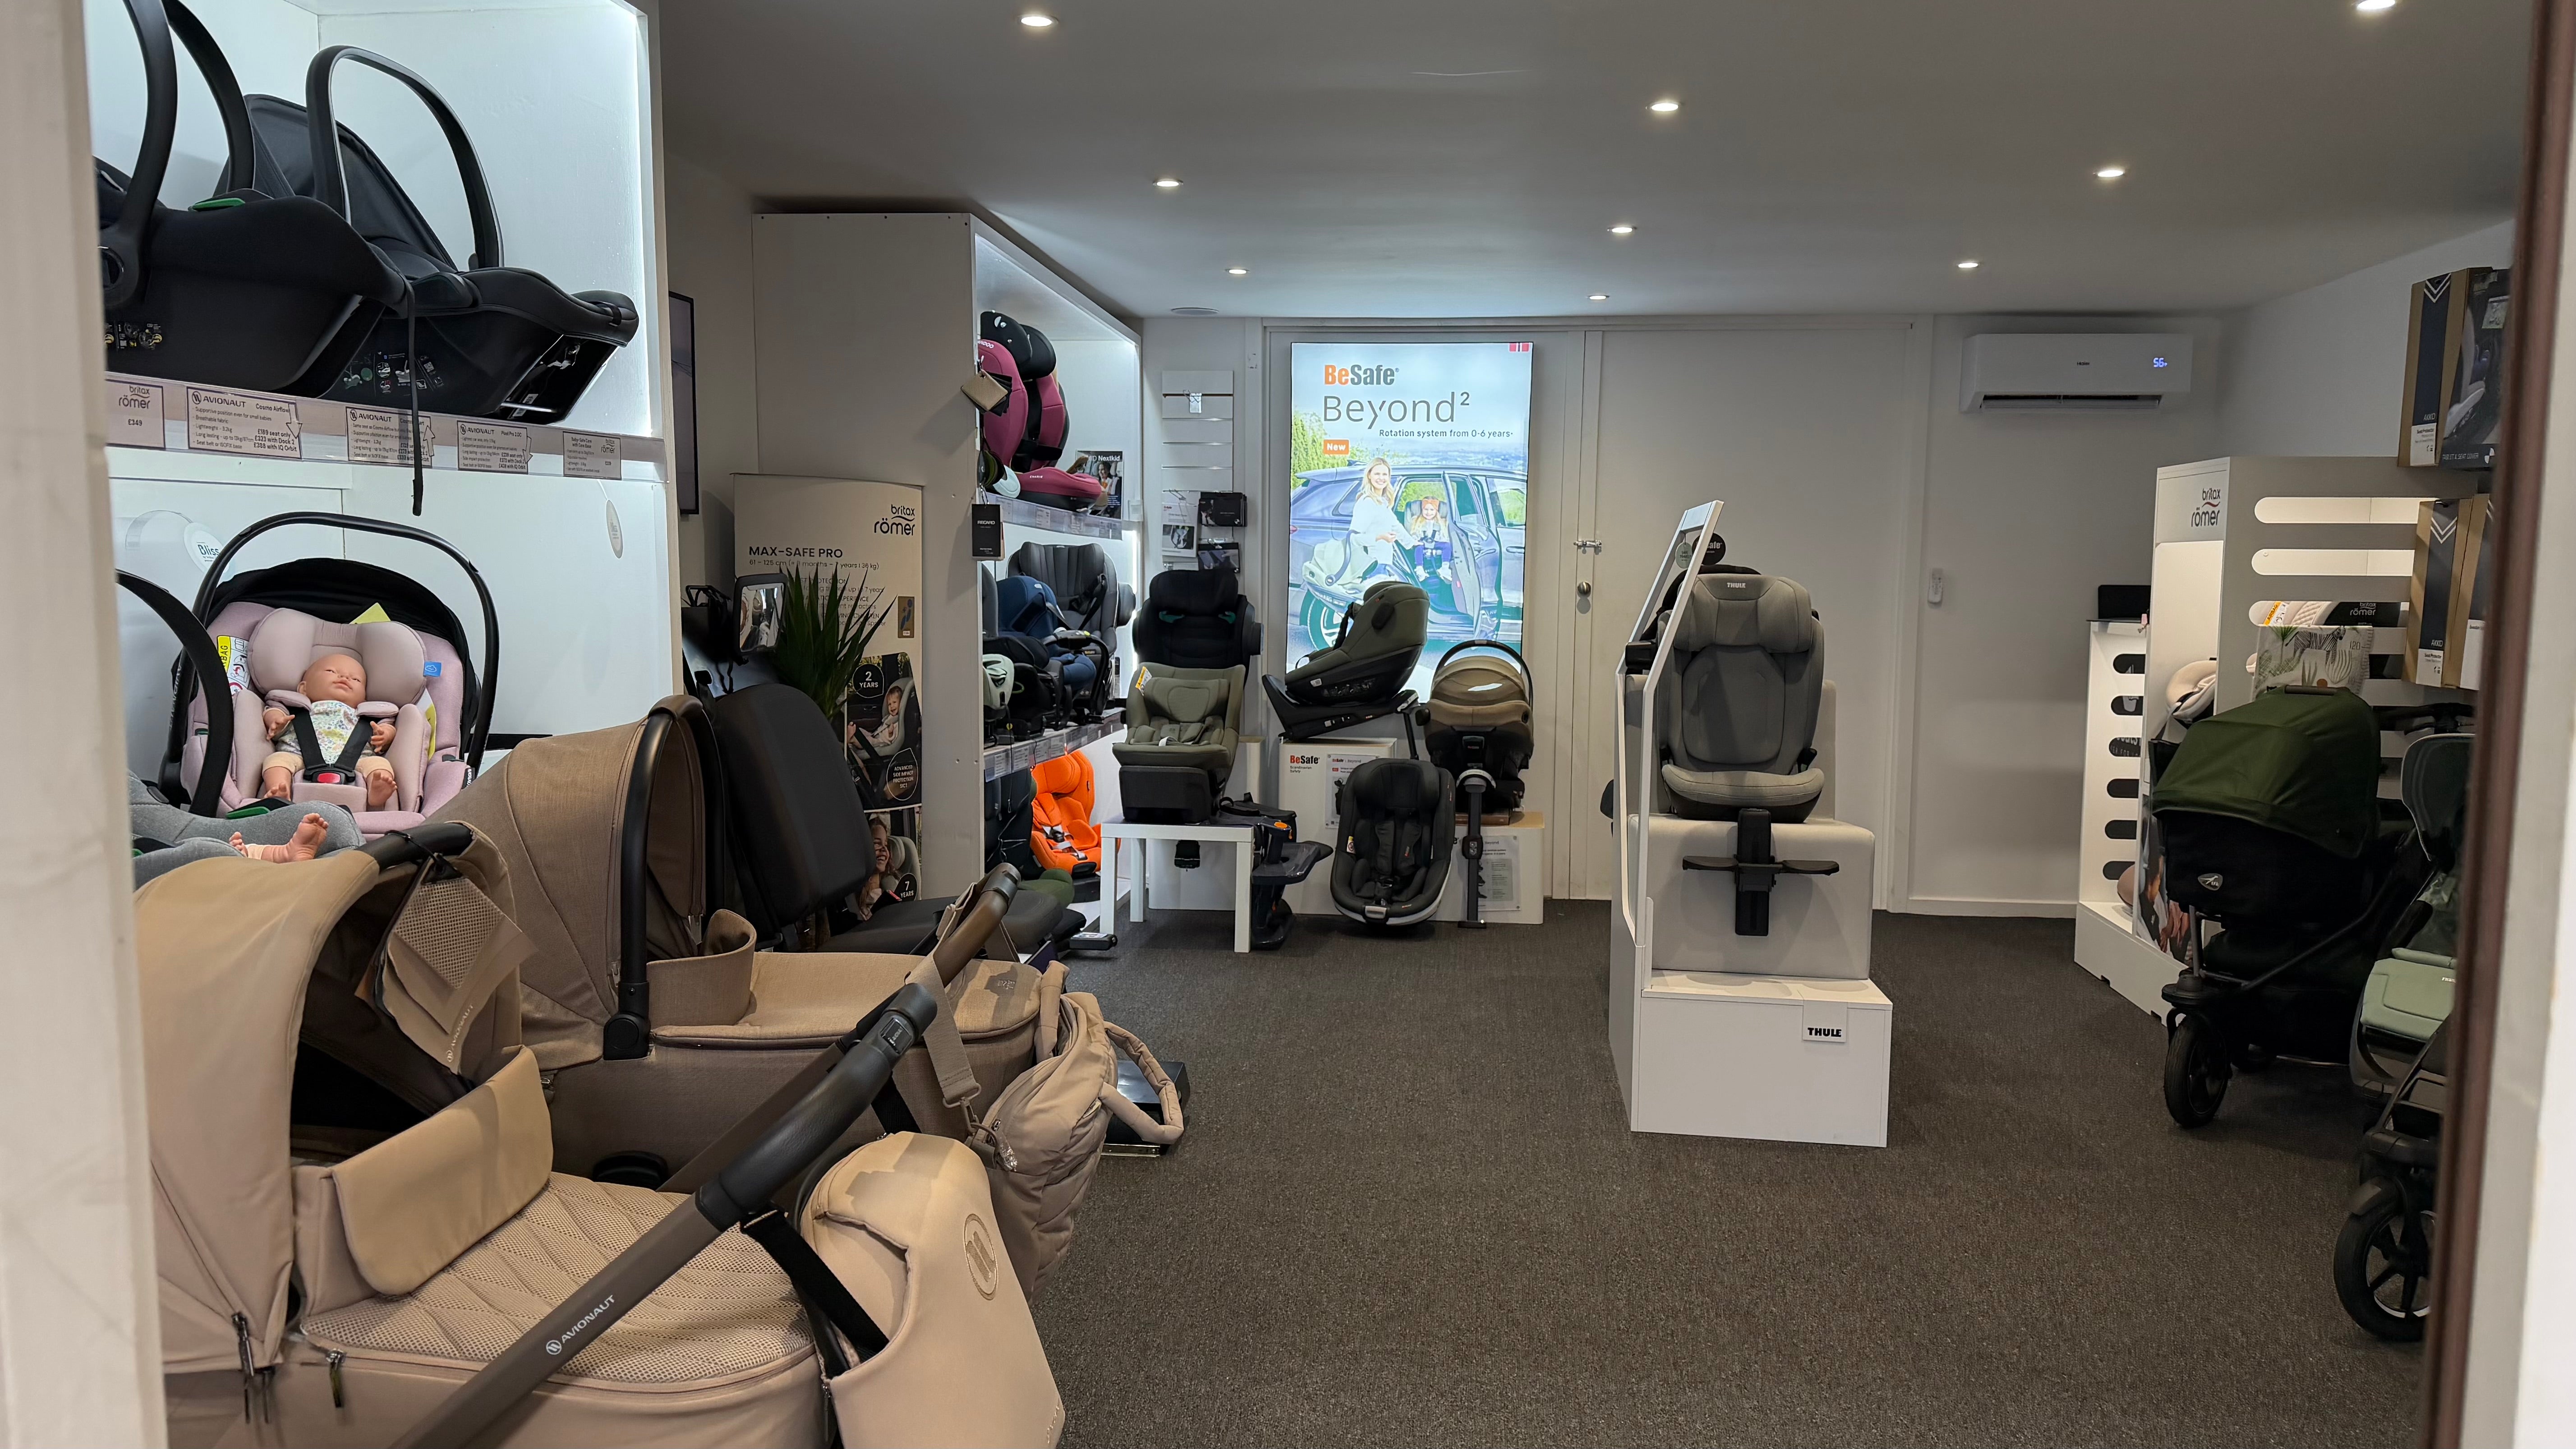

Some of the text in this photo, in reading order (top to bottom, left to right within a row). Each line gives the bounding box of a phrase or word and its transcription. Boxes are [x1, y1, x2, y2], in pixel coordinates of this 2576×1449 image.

[1325, 364, 1395, 385] BeSafe
[129, 385, 150, 395] britax
[119, 395, 150, 409] römer
[203, 396, 246, 408] AVIONAUT
[256, 403, 272, 411] Cosmo
[359, 413, 392, 422] AVIONAUT
[1326, 443, 1346, 451] New
[2202, 488, 2221, 501] britax
[891, 504, 915, 516] britax
[2191, 507, 2220, 527] römer
[874, 518, 915, 536] römer
[749, 546, 842, 558] MAX-SAFE PRO
[2350, 640, 2361, 650] 120
[220, 645, 228, 667] BAG
[865, 671, 872, 681] 2
[1290, 755, 1319, 764] BeSafe
[905, 881, 910, 891] 7
[1807, 1027, 1842, 1037] THULE
[561, 1294, 615, 1343] AVIONAUT
